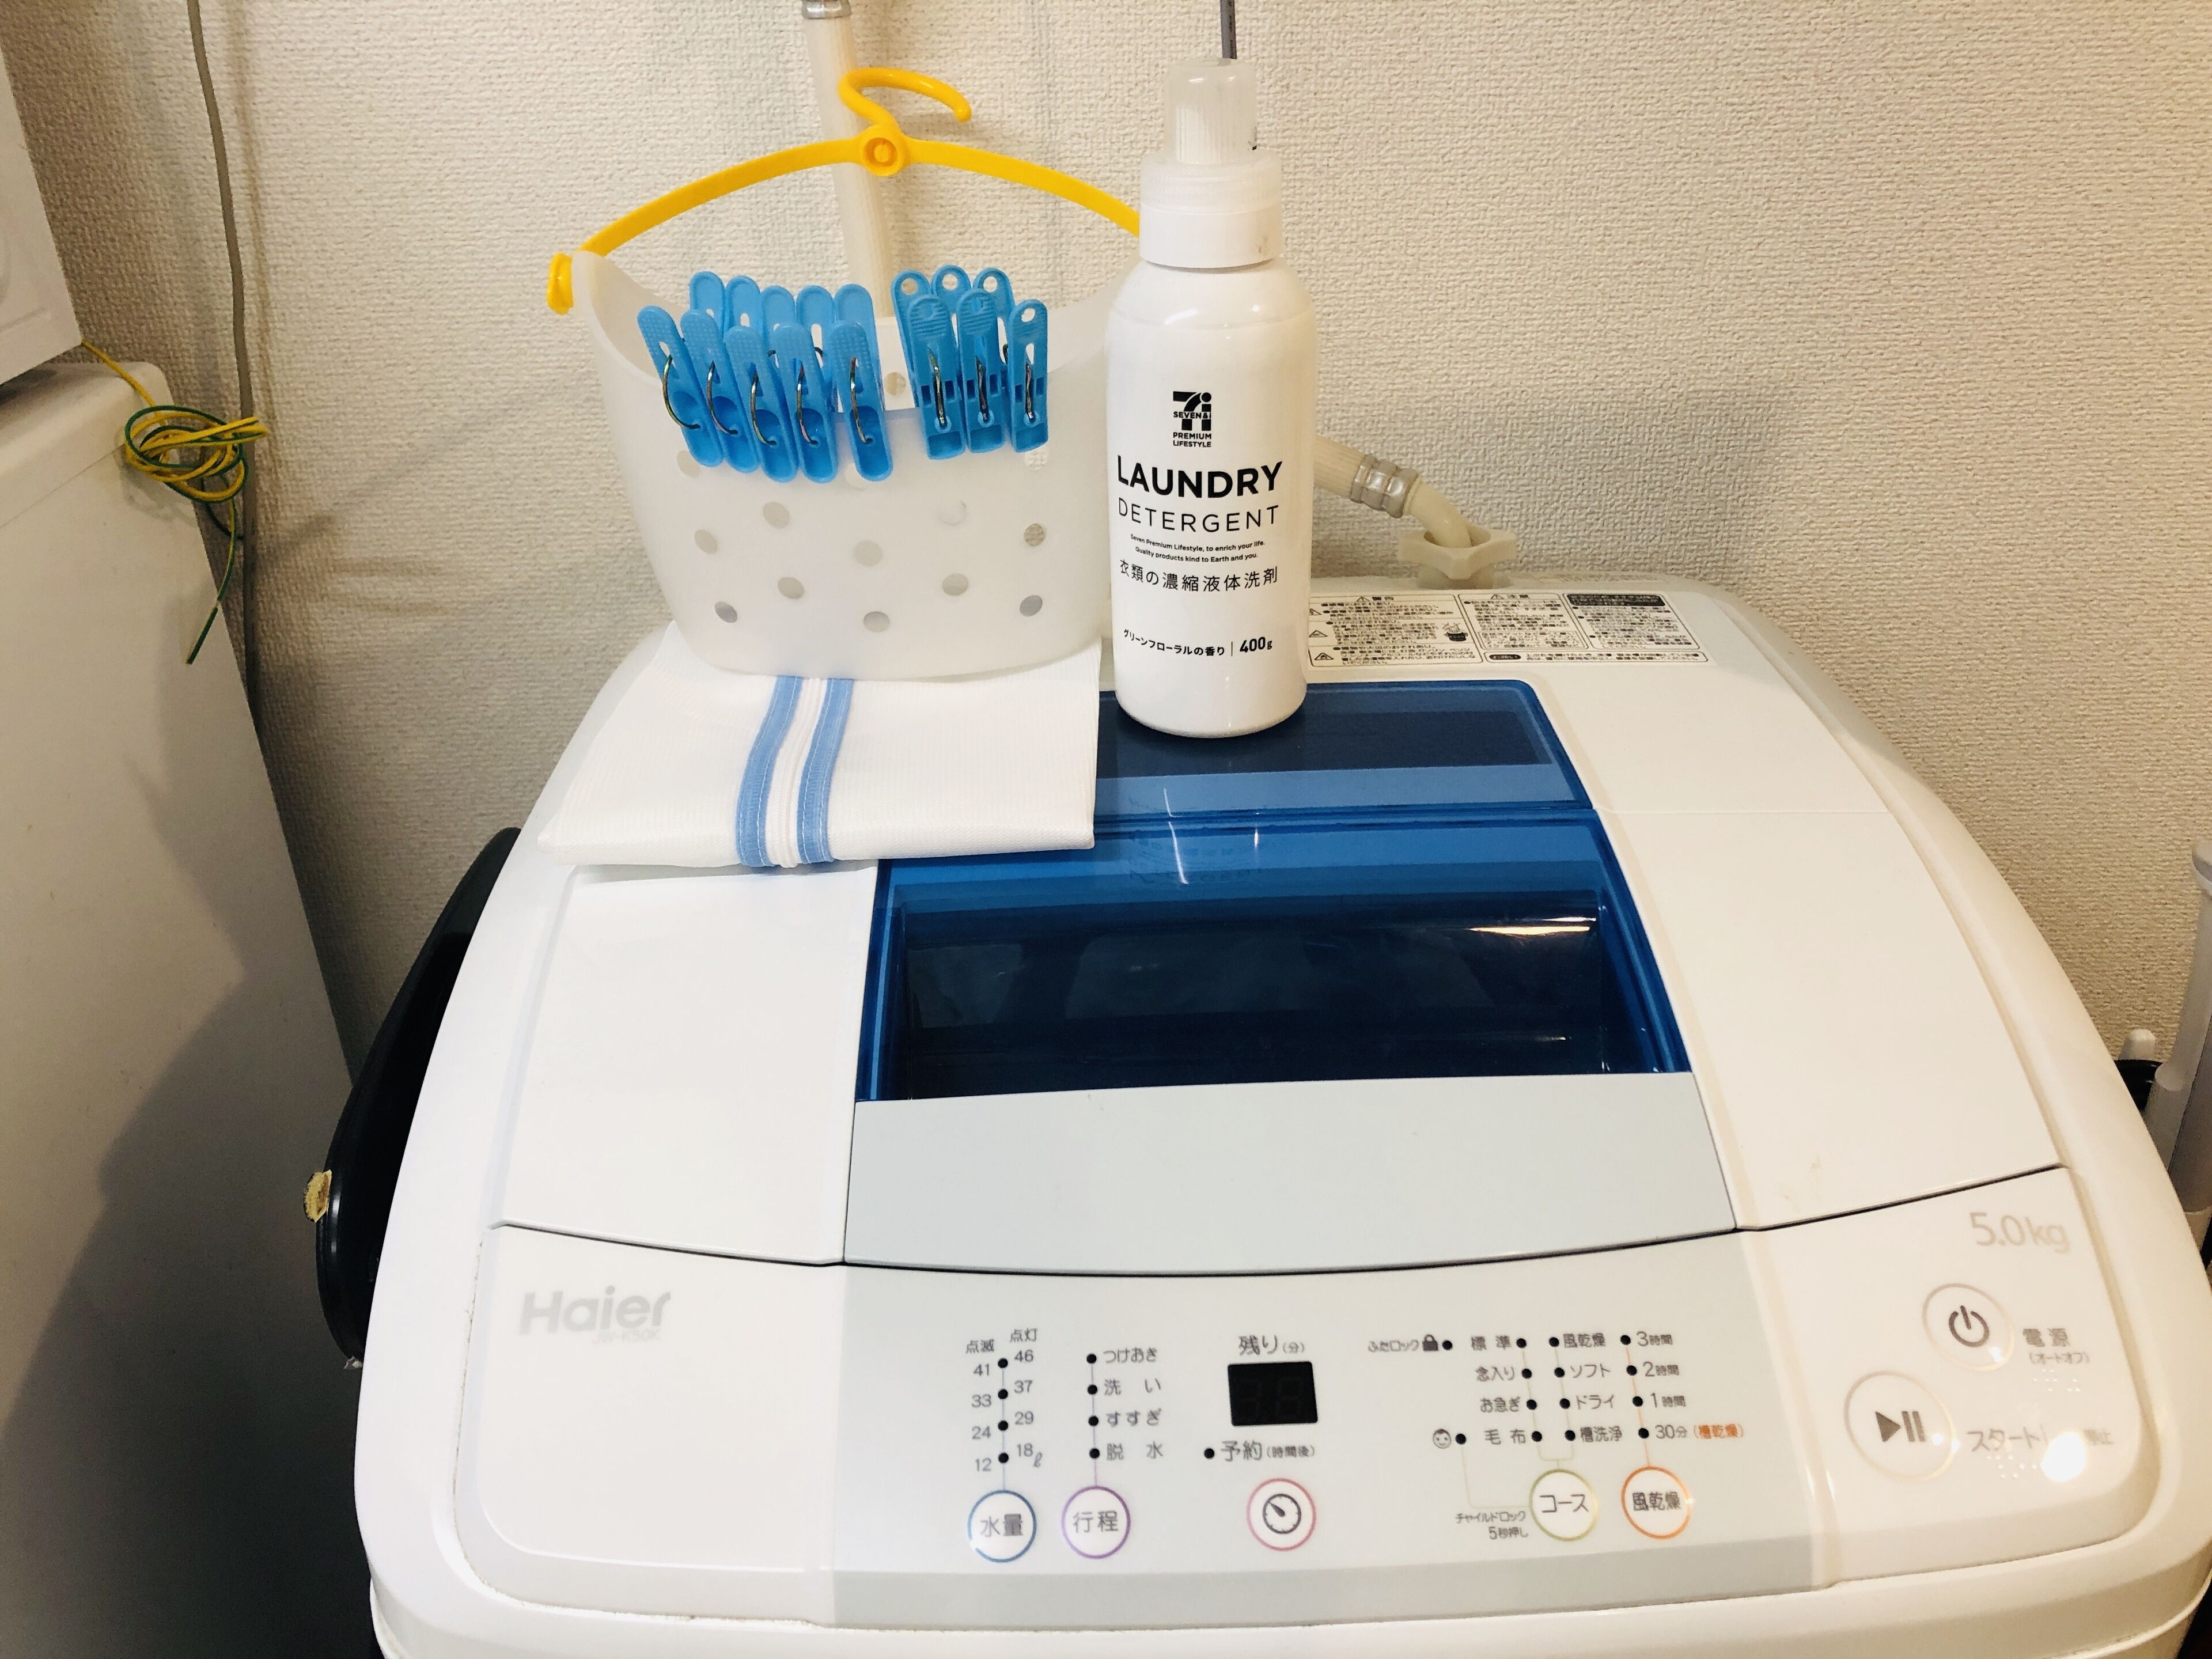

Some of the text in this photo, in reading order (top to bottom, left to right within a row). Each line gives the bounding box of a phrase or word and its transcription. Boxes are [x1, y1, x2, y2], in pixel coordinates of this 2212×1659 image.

[1173, 432, 1212, 440] PREMIUM
[1173, 440, 1211, 448] LIFESTYLE
[1118, 455, 1283, 499] LAUNDRY
[1119, 497, 1279, 533] DETERGENT
[1130, 533, 1145, 544] Seven
[1146, 539, 1173, 550] Premium
[1174, 544, 1205, 552] Lifestyle,
[1237, 543, 1253, 551] your
[1135, 546, 1154, 558] Quality
[1155, 552, 1184, 562] products
[1244, 553, 1259, 561] you.
[1120, 559, 1278, 592] 衣類の濃縮液体洗剤
[1124, 629, 1272, 657] グリーンフローラルの香り 400g
[1969, 1211, 2070, 1254] 5.0kg
[520, 1285, 672, 1335] Haier
[1009, 1328, 1037, 1343] 点灯
[1563, 1332, 1606, 1348] 風乾燥
[1636, 1331, 1673, 1347] 3時間
[965, 1339, 995, 1353] 点滅
[1368, 1339, 1419, 1353] ふたロック
[1014, 1349, 1034, 1362] 46
[1103, 1347, 1157, 1363] つけおき
[973, 1363, 990, 1376] 41
[1475, 1366, 1515, 1382] 念入り
[1570, 1363, 1611, 1378] ソフト
[1642, 1361, 1680, 1377] 2時間
[1014, 1380, 1033, 1393] 37
[971, 1393, 992, 1408] 33
[1480, 1396, 1521, 1413] お急ぎ
[1575, 1394, 1615, 1410] ドライ
[1650, 1392, 1686, 1408] 1時間
[1014, 1410, 1034, 1425] 29
[972, 1425, 991, 1440] 24
[1580, 1425, 1623, 1442] 槽洗浄
[1966, 1426, 2040, 1452] スタート
[1017, 1442, 1033, 1457] 18
[975, 1459, 993, 1472] 12
[1539, 1494, 1589, 1513] コース
[1632, 1491, 1680, 1512] 風乾燥
[983, 1513, 1024, 1536] 水量
[1073, 1510, 1119, 1533] 行程
[1455, 1510, 1526, 1524] チャイルドロック
